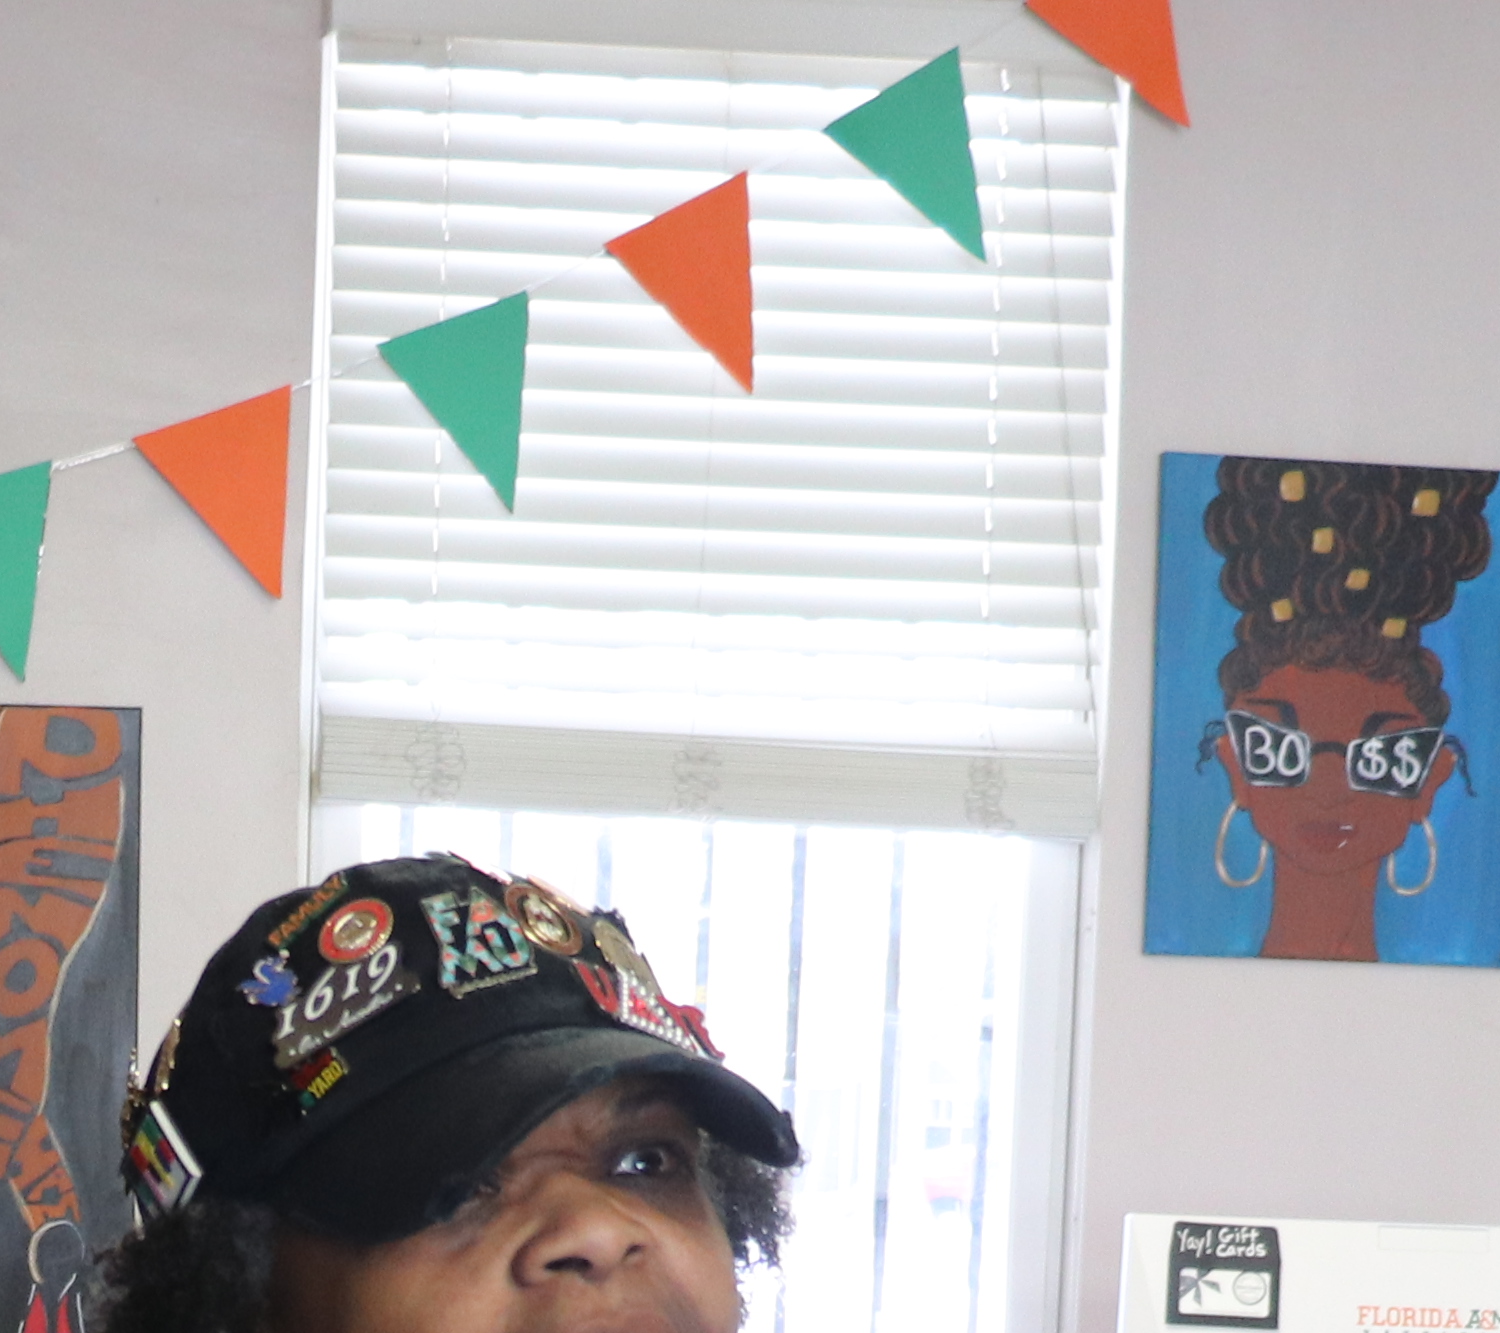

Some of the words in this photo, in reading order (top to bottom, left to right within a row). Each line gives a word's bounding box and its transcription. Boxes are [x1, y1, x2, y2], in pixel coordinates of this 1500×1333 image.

[278, 944, 399, 1041] 1619
[307, 1060, 344, 1102] YARD
[1176, 1228, 1213, 1259] Yay!
[1217, 1226, 1260, 1243] Gift
[1356, 1305, 1463, 1329] FLORIDA
